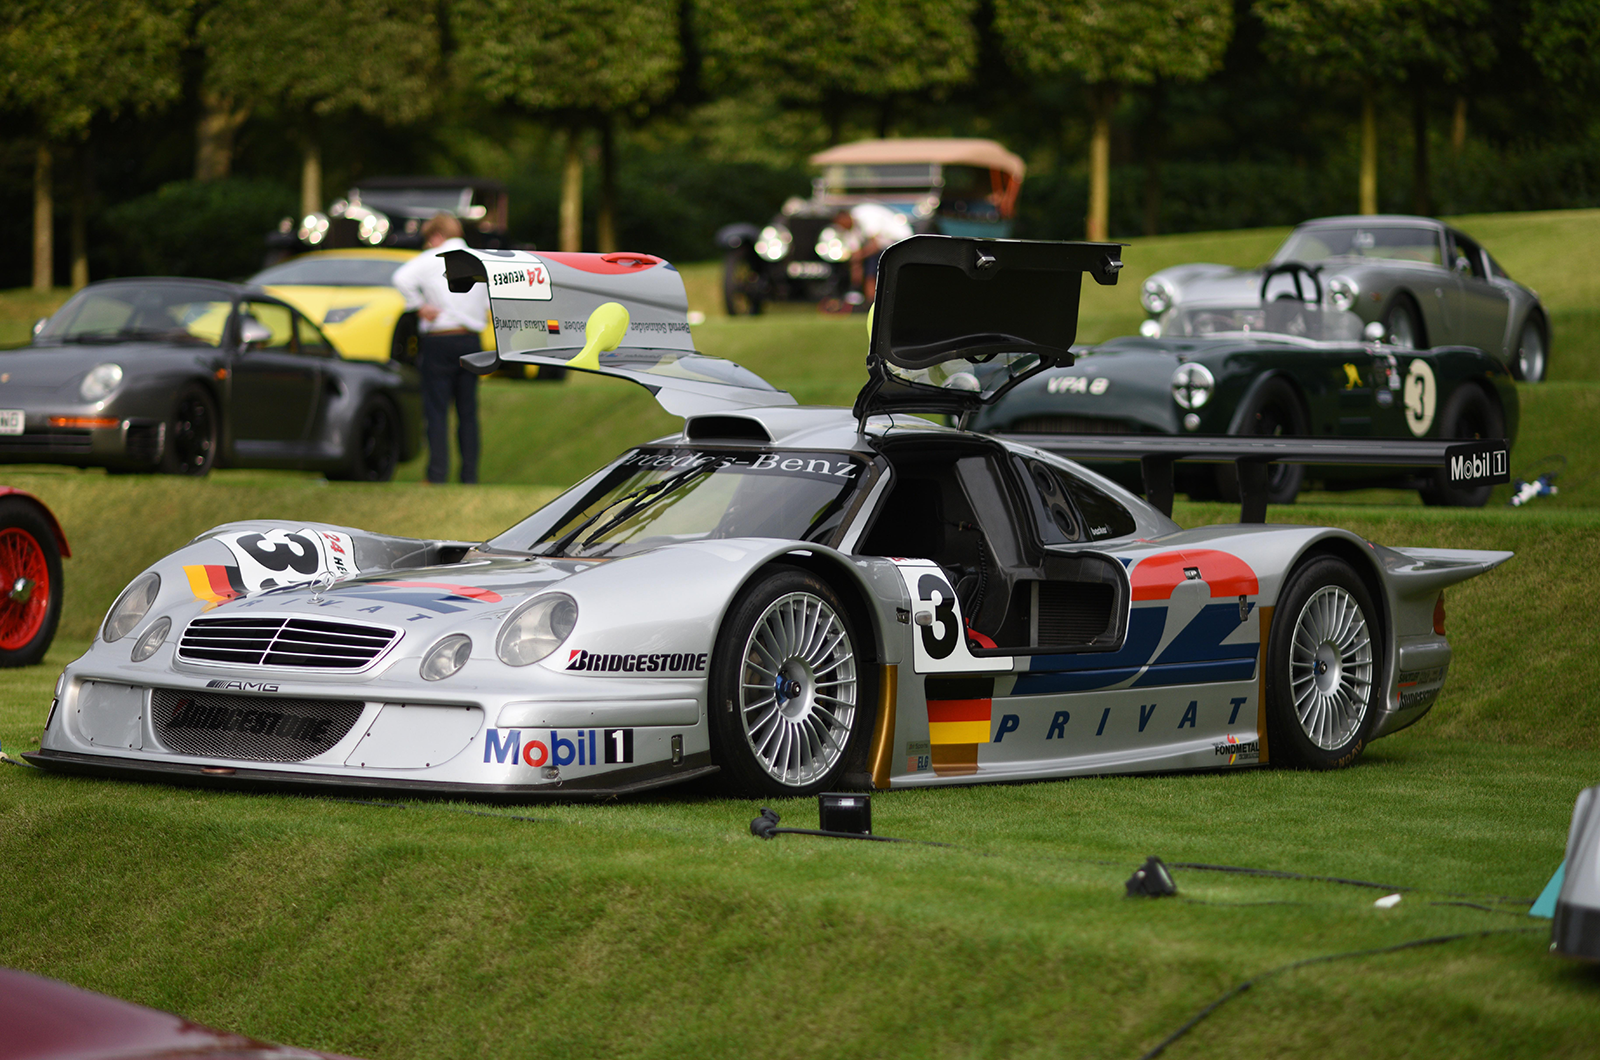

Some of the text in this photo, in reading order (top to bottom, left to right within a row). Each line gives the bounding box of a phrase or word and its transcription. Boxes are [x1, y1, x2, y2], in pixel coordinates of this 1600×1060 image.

[493, 267, 545, 287] 24 HEURES
[494, 317, 546, 332] Klaus Ludwig
[630, 321, 691, 334] Bernd Schneider
[1047, 376, 1088, 394] VPA
[1413, 374, 1426, 421] 3
[1450, 452, 1490, 481] Mobil
[236, 532, 320, 575] 3
[321, 532, 346, 555] 24
[917, 573, 959, 660] 3
[565, 649, 708, 672] BRIDGESTONE
[224, 680, 281, 693] AMG
[993, 697, 1248, 743] PRIVAT
[483, 728, 597, 768] Mobil
[1215, 742, 1259, 756] FONDMETAL
[917, 755, 929, 768] ELG
